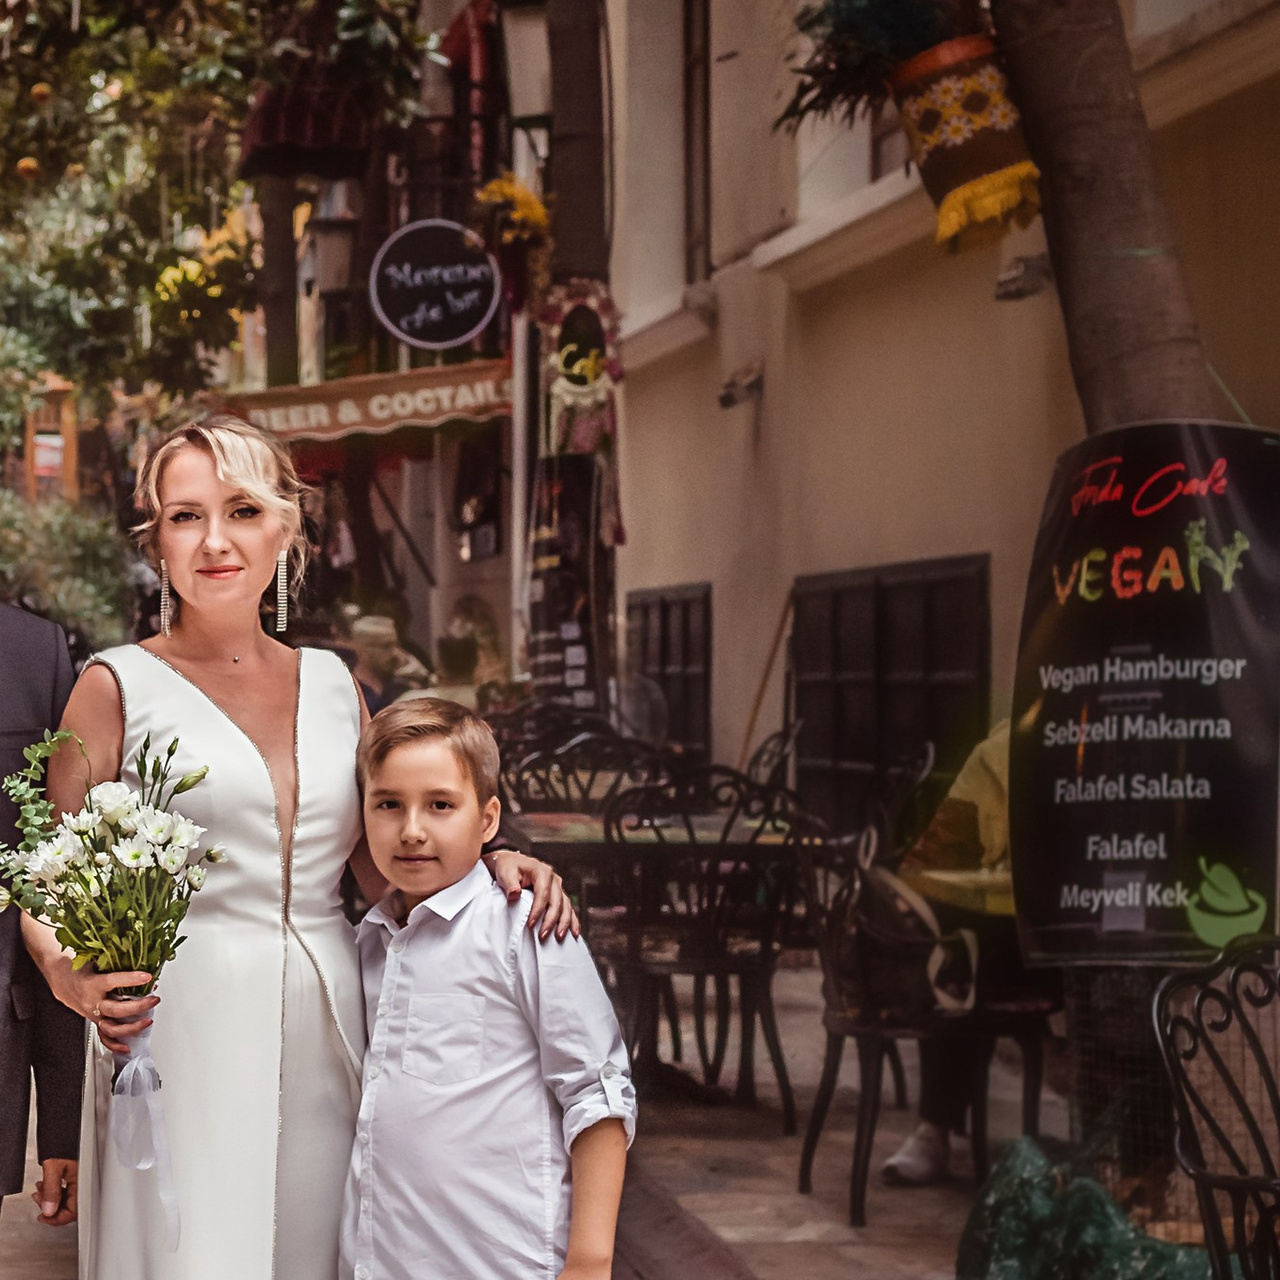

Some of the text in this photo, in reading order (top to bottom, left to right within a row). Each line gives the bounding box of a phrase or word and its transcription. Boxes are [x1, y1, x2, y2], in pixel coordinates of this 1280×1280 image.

[337, 398, 361, 424] &
[1053, 518, 1250, 606] VEGAN
[1039, 653, 1247, 693] Vegan Hamburger
[1043, 713, 1231, 747] Sebzeli Makarna
[1054, 773, 1211, 803] Falafel Salata
[1086, 832, 1167, 860] Falafel
[1060, 881, 1189, 914] Meyveli Kek
